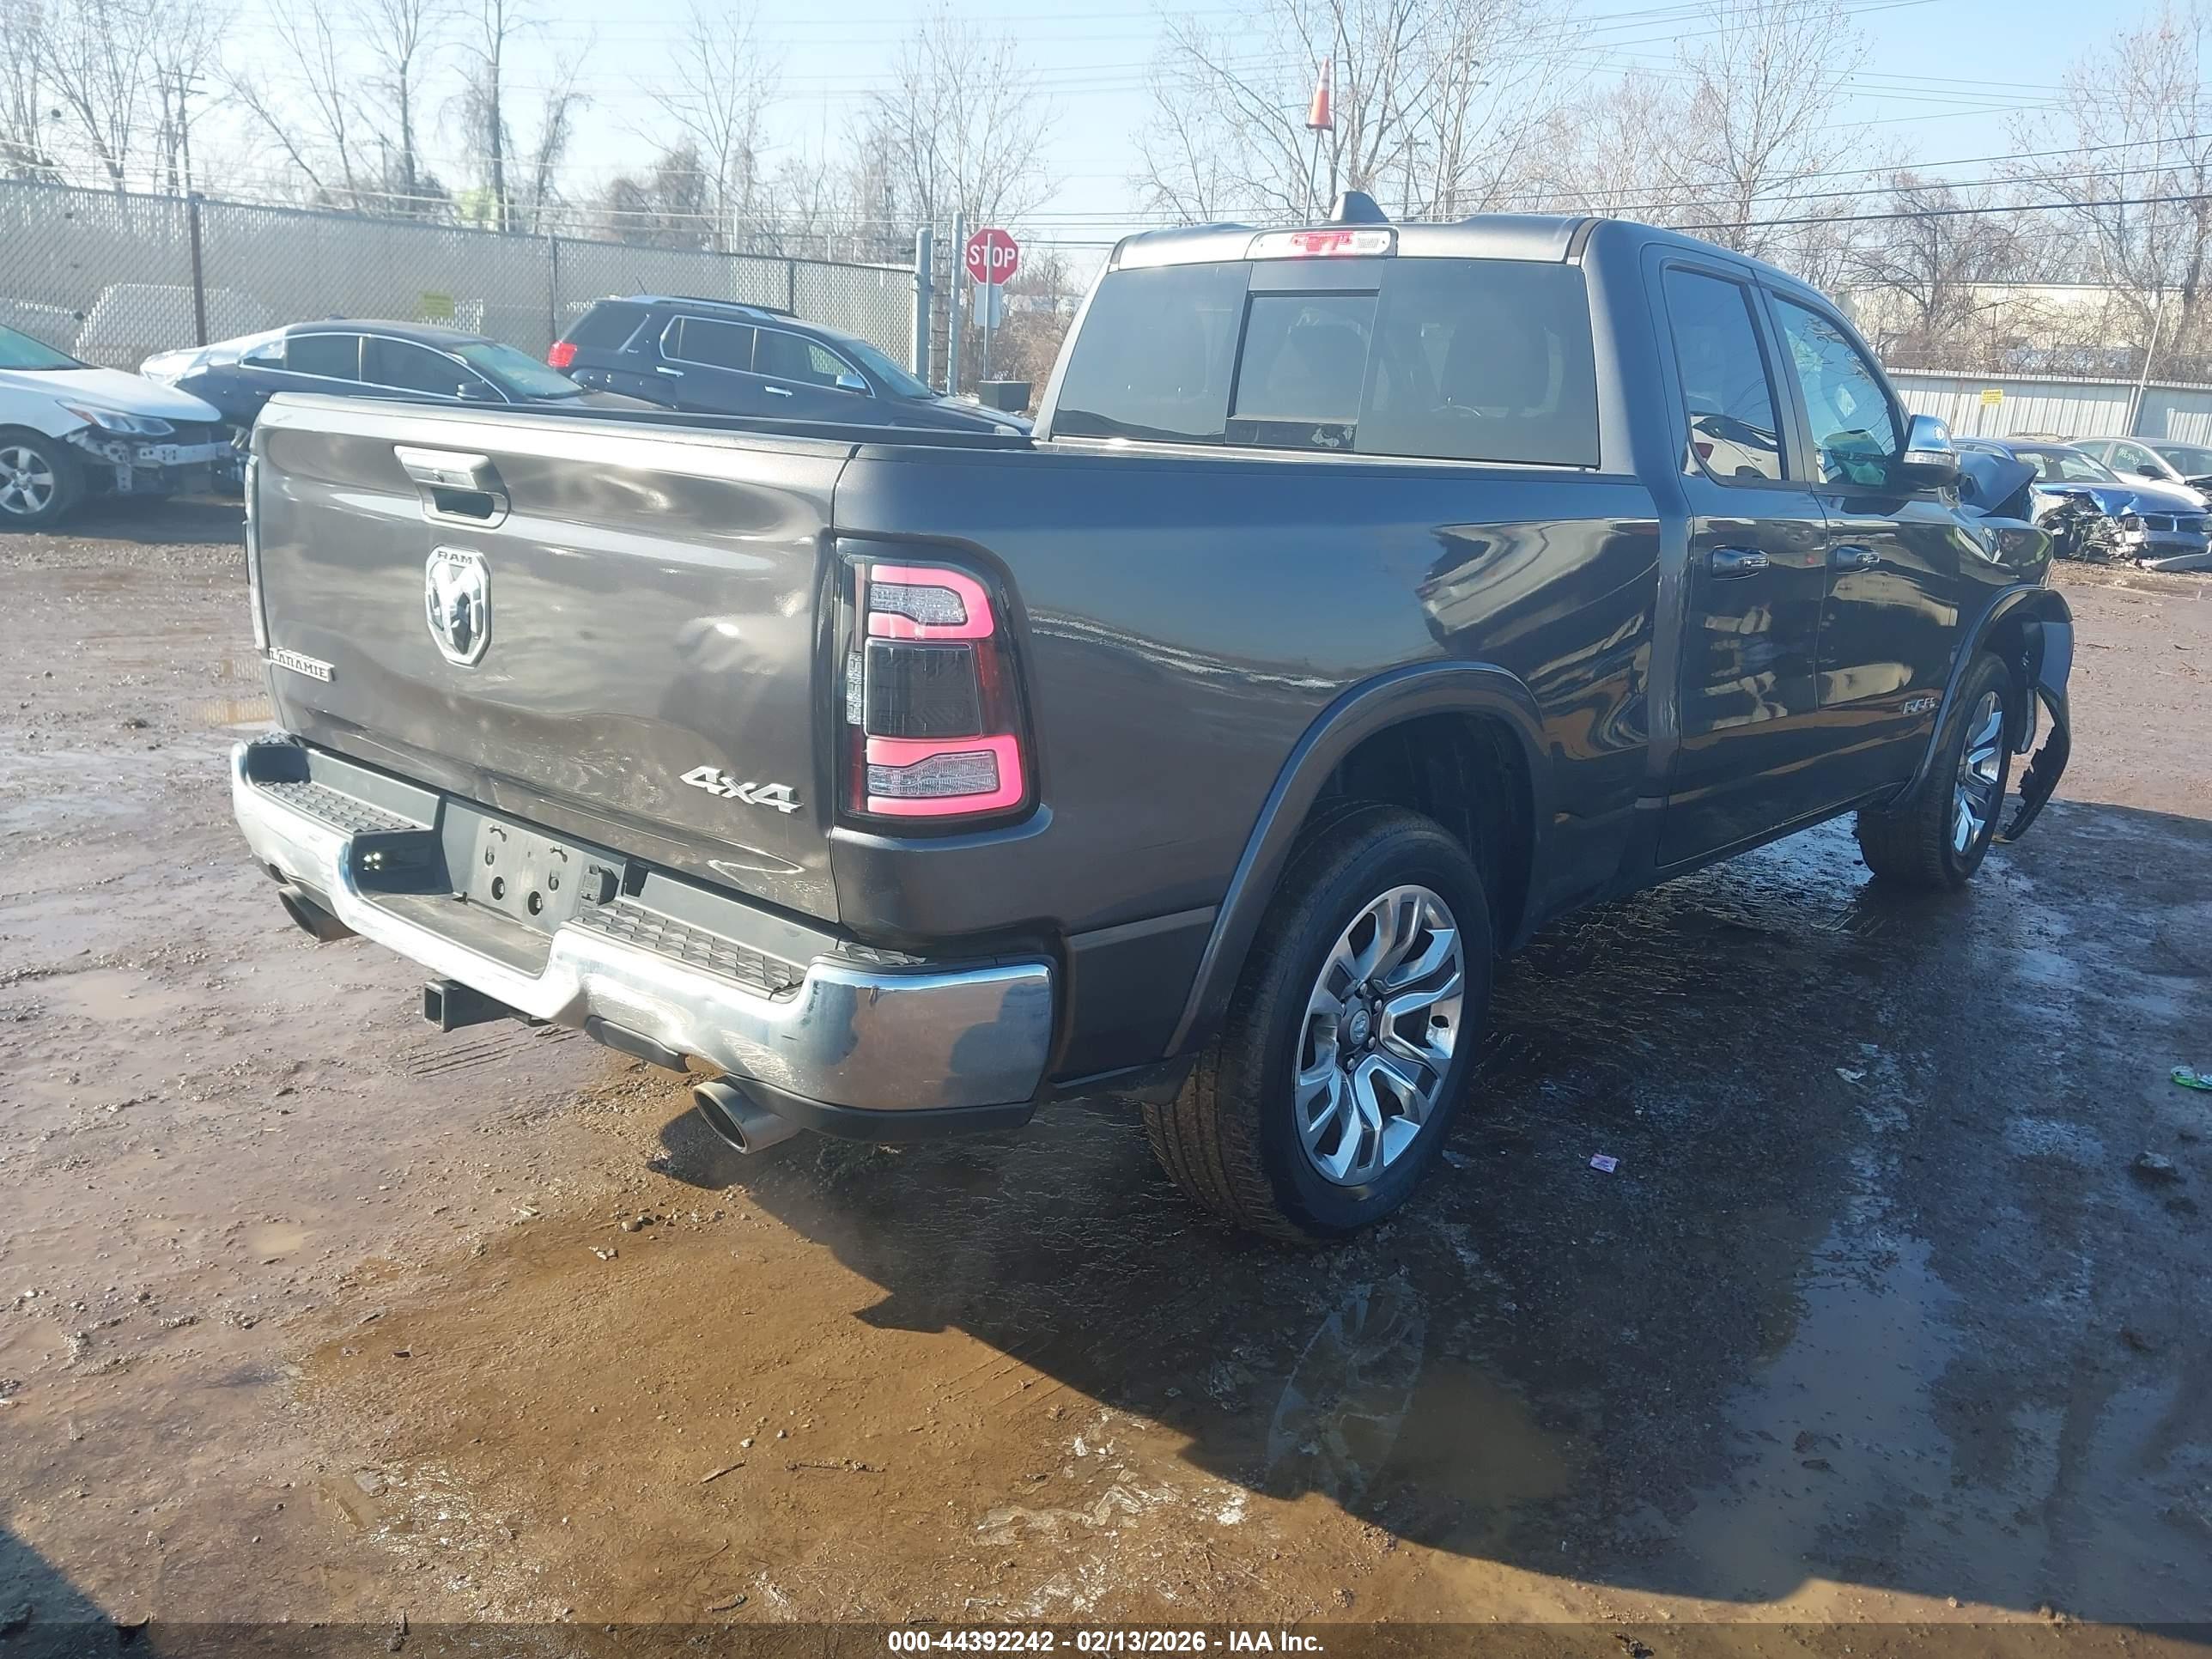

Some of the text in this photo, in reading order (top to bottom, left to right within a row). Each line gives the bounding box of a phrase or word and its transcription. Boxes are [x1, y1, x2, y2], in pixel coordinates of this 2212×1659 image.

[968, 244, 1017, 268] STOP
[436, 550, 474, 565] RAM
[270, 649, 329, 679] LARAMIE
